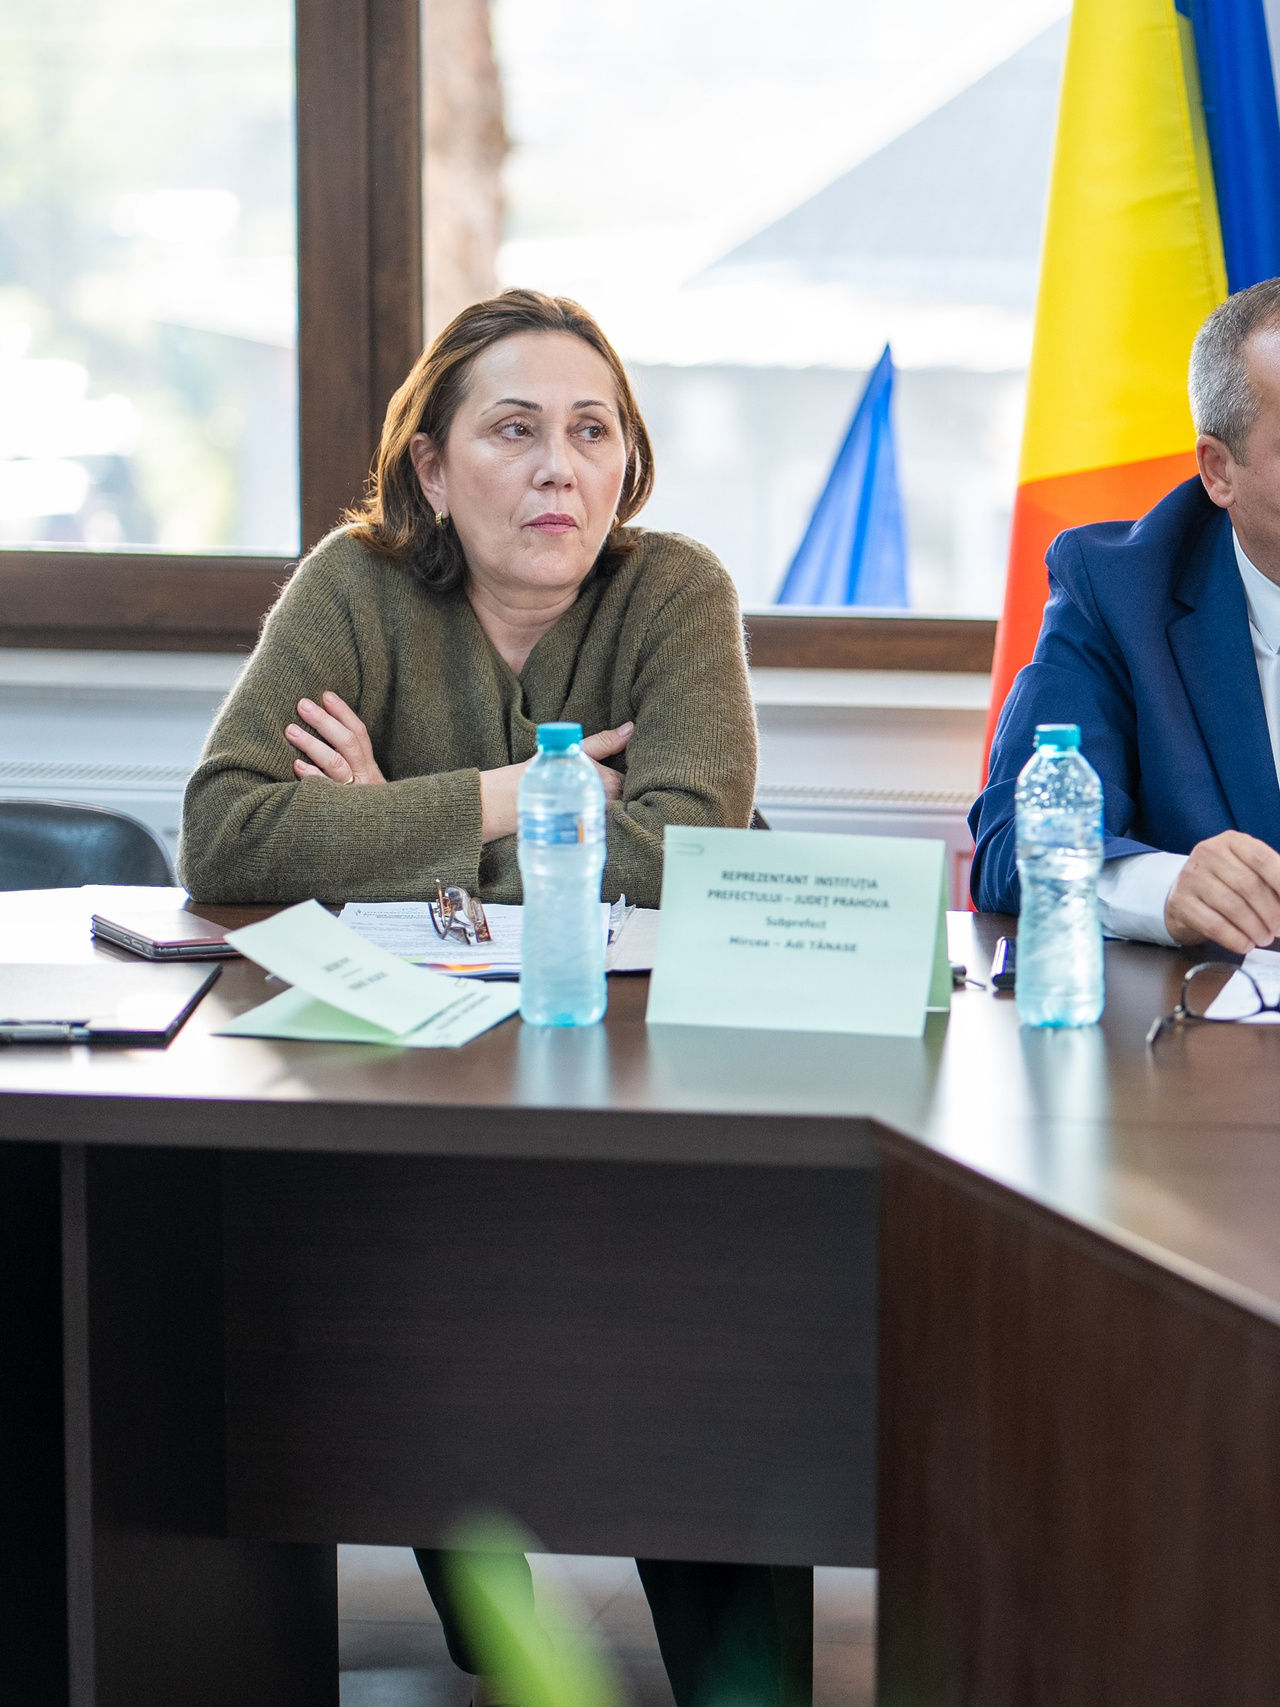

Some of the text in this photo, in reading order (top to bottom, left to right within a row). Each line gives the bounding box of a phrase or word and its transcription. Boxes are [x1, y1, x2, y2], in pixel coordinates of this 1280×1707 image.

[721, 869, 809, 885] REPREZENTANT
[707, 888, 783, 904] PREFECTULUI
[832, 896, 891, 910] PRAHOVA
[765, 915, 827, 930] Subprefect
[729, 935, 769, 948] Mircea
[785, 938, 805, 950] Adi
